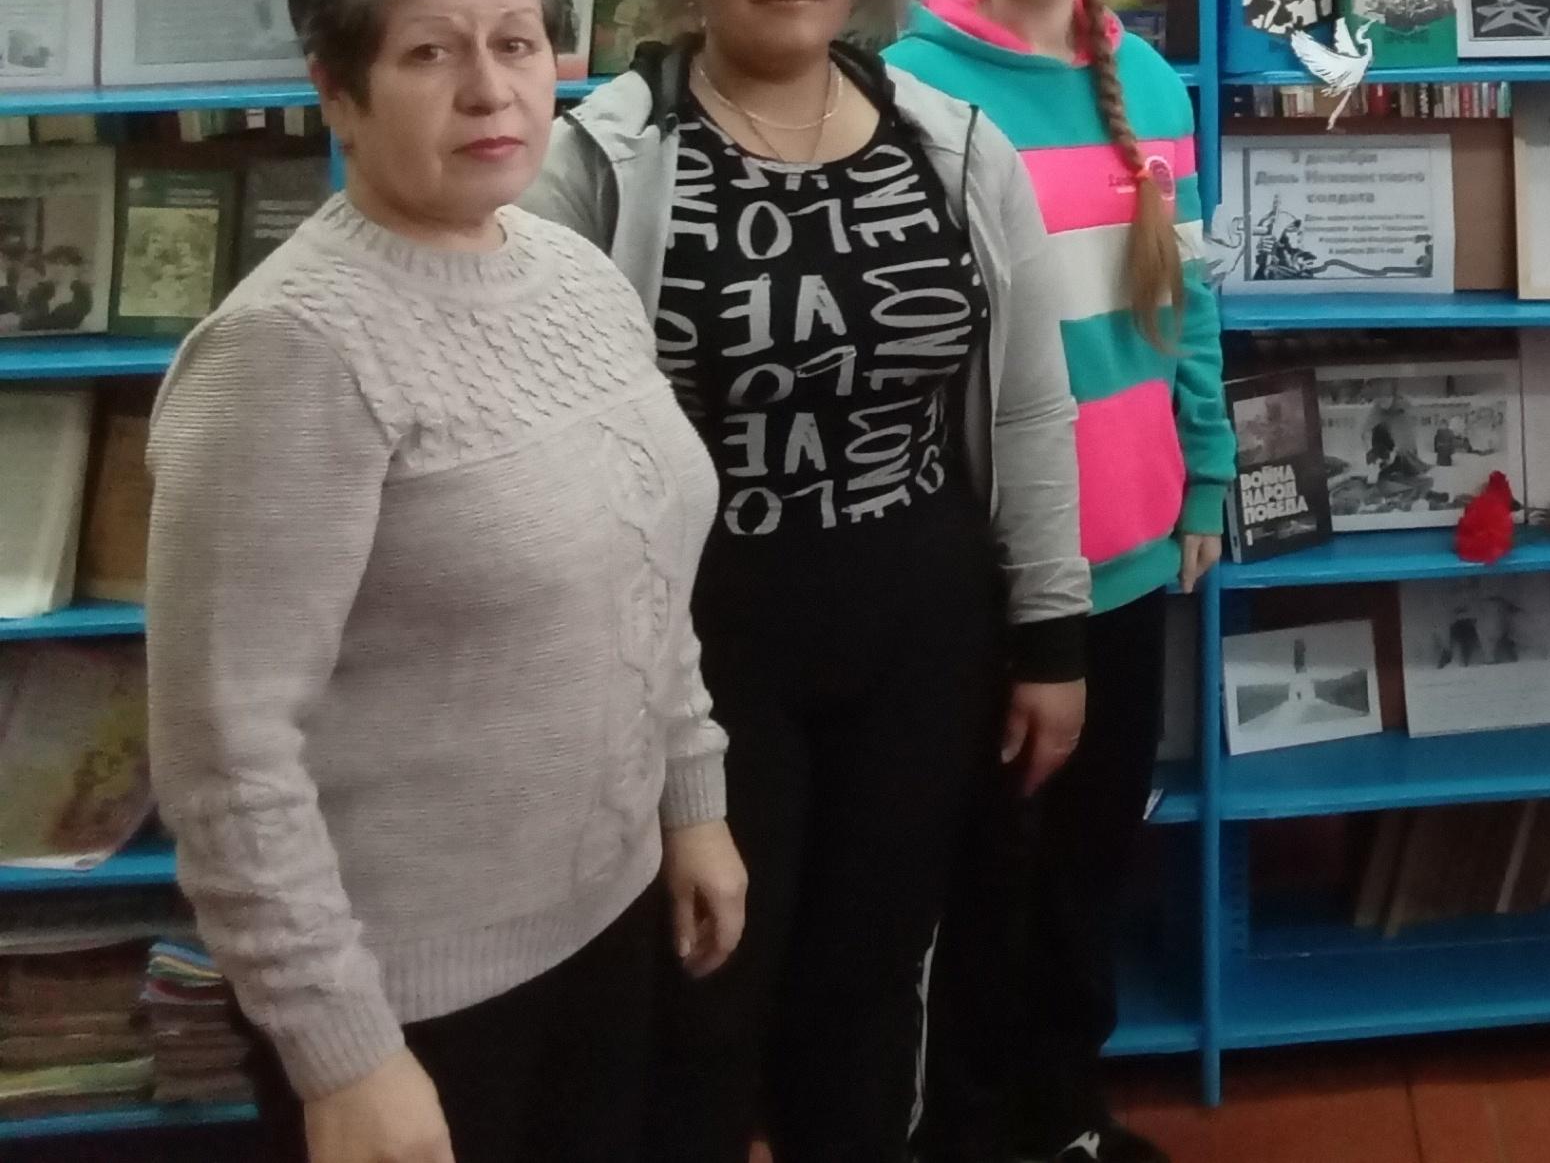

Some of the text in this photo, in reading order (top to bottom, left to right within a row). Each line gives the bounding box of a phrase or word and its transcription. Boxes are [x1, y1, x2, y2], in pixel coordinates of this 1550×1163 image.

[861, 258, 972, 391] LOVE
[840, 397, 923, 525] LOVE
[1239, 463, 1296, 491] ВОЙНА
[1243, 495, 1309, 525] ПОБЕДА
